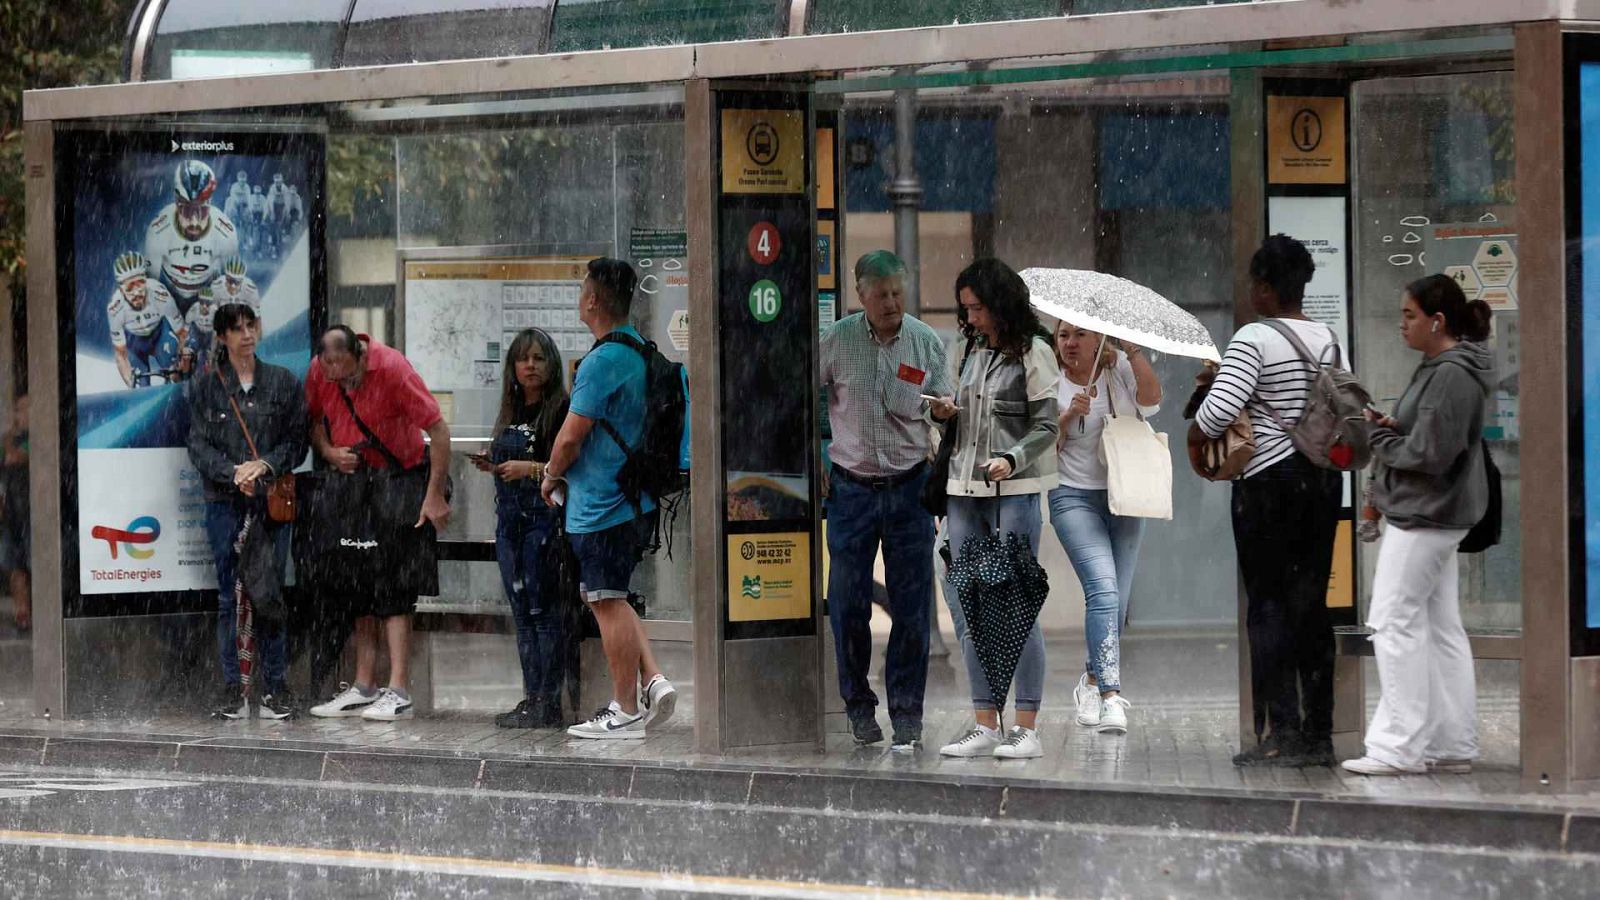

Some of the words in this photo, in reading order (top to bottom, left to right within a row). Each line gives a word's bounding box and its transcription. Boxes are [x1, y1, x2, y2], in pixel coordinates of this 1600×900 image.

[181, 140, 234, 152] exteriorplus
[757, 230, 771, 257] 4
[753, 287, 777, 315] 16
[90, 568, 162, 582] TotalEnergies
